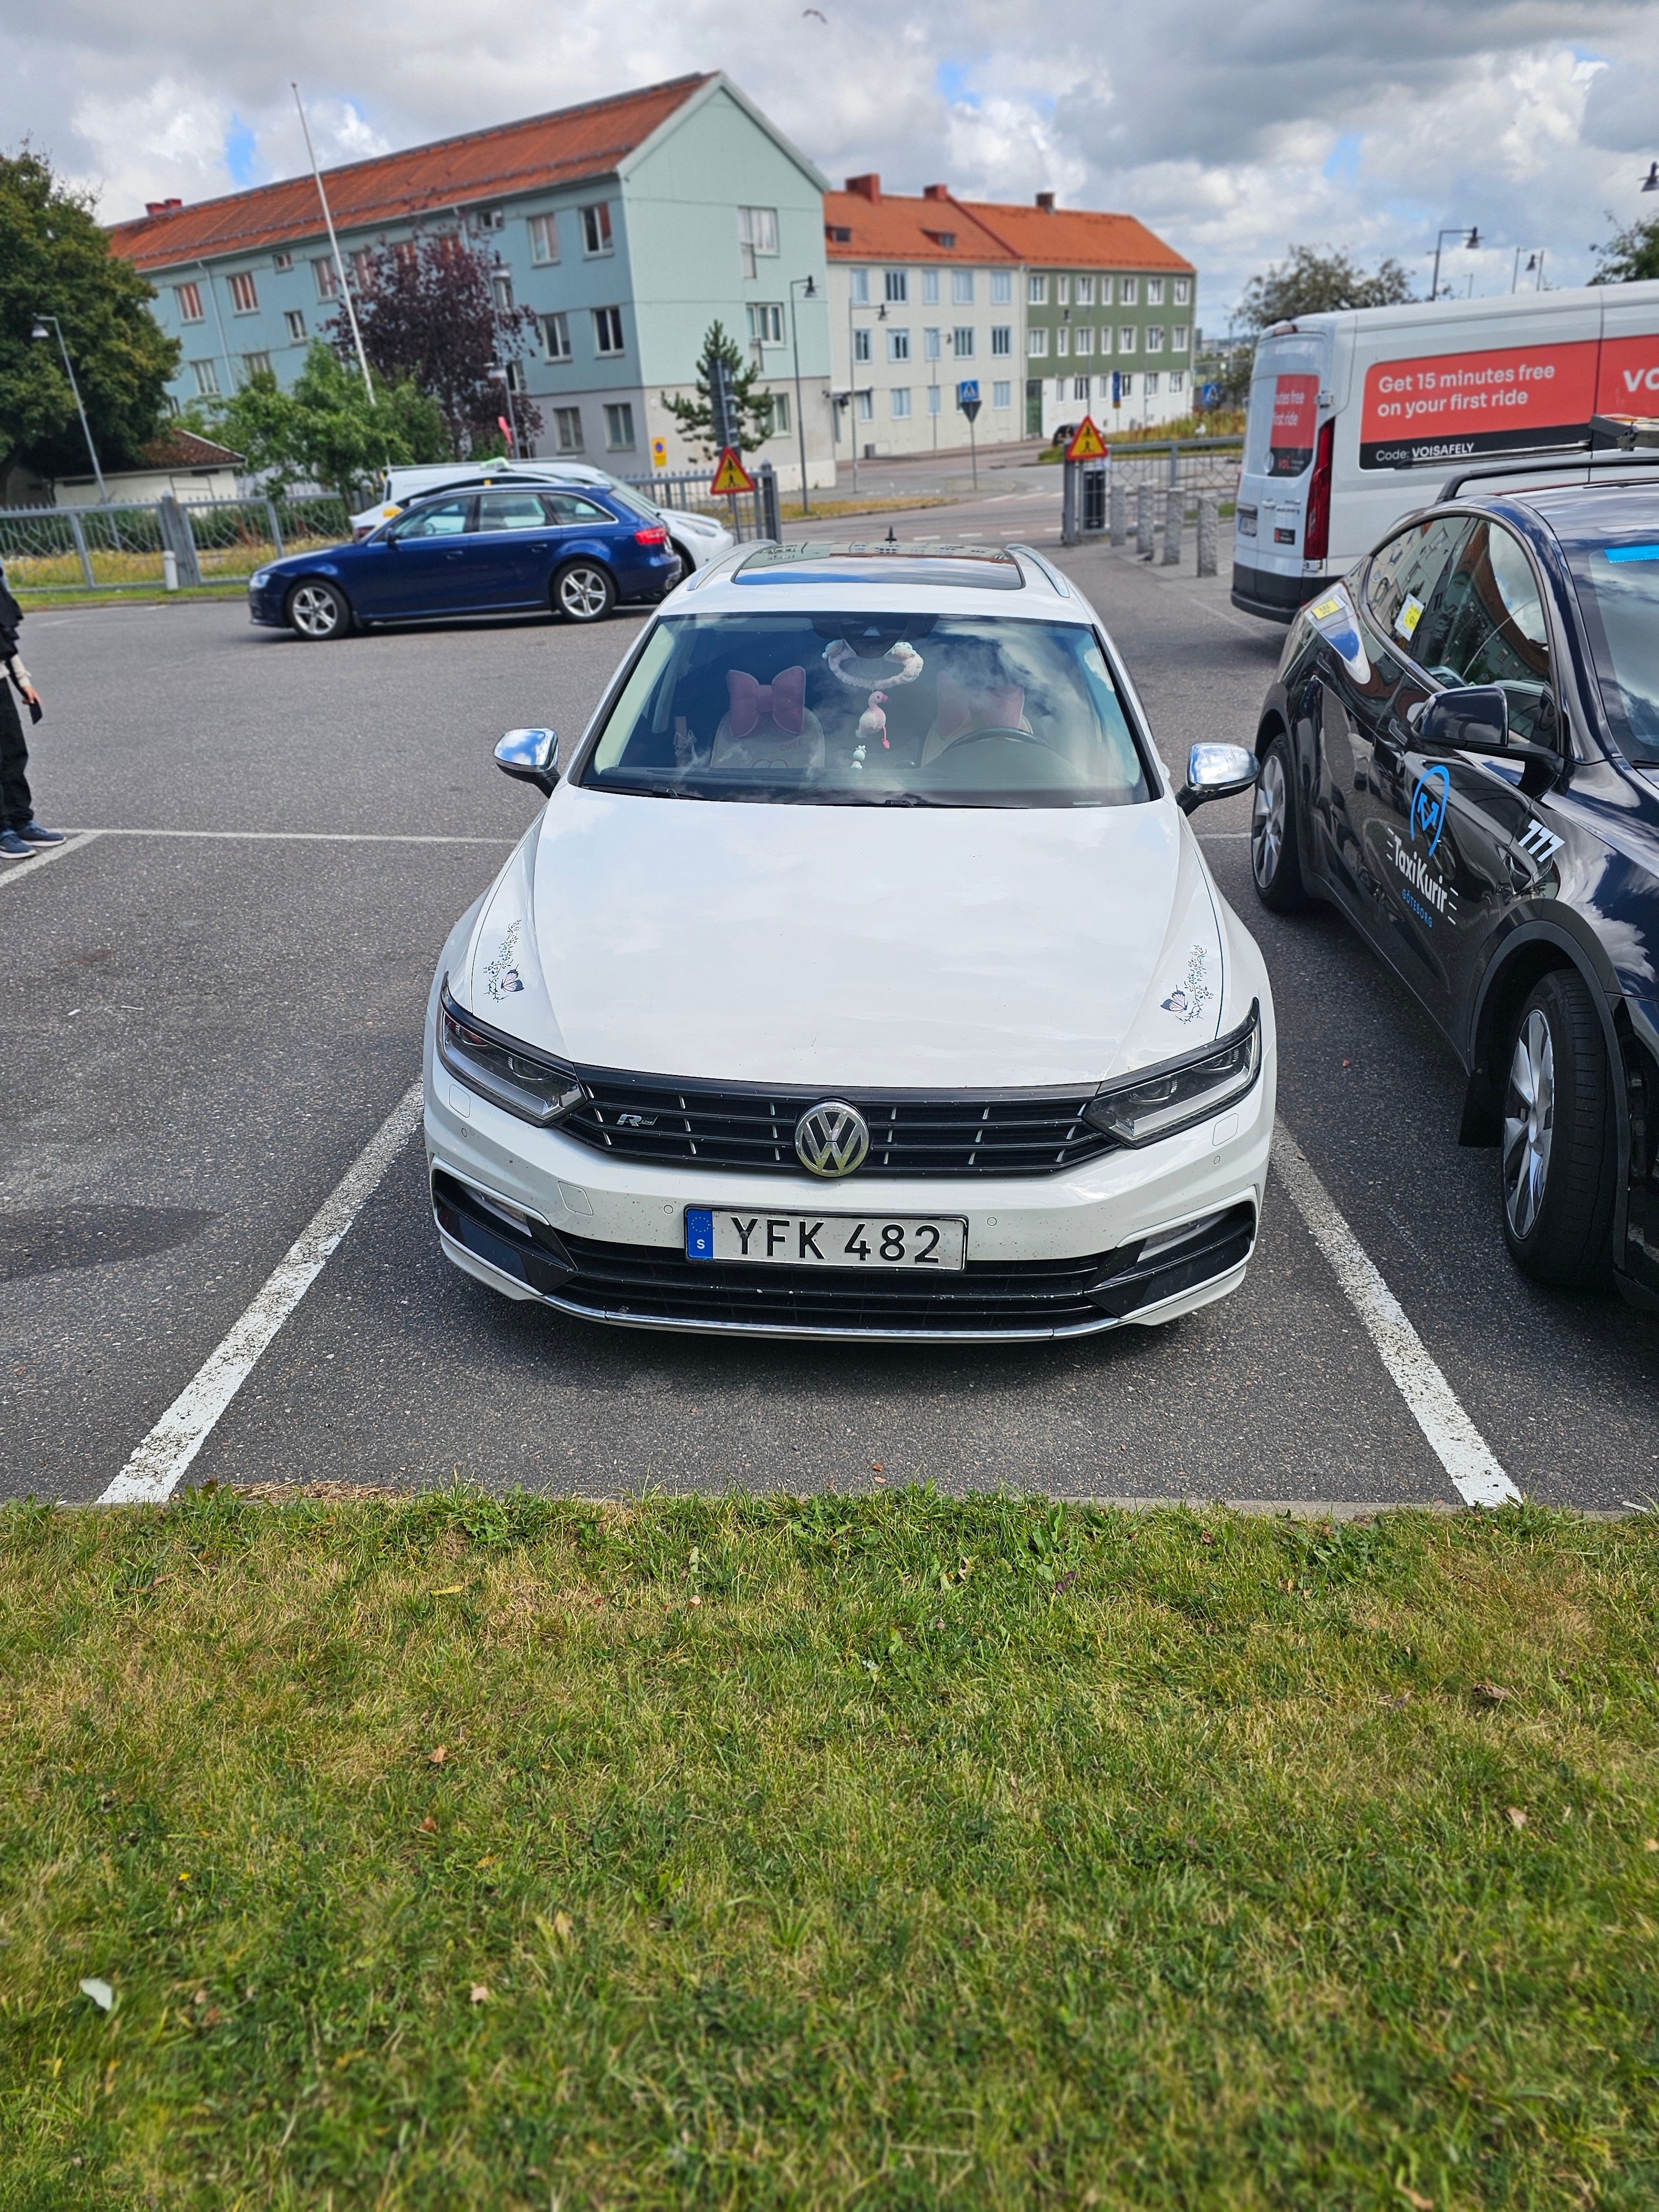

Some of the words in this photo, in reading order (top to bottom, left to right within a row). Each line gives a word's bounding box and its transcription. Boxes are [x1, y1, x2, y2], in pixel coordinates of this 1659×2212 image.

[1379, 375, 1412, 393] Get
[1417, 372, 1436, 389] 15
[1440, 368, 1515, 388] minutes
[1519, 364, 1555, 380] free
[1378, 403, 1401, 416] on
[1405, 398, 1447, 418] your
[1451, 392, 1487, 410] first
[1491, 389, 1528, 406] ride
[1285, 411, 1298, 426] ride
[1376, 448, 1409, 461] Code:
[1412, 443, 1474, 457] VOISAFELY
[1518, 819, 1566, 863] 777
[1402, 888, 1433, 928] GÖTEBORG
[697, 1238, 705, 1250] S
[731, 1215, 826, 1260] YFK
[844, 1223, 941, 1264] 482
